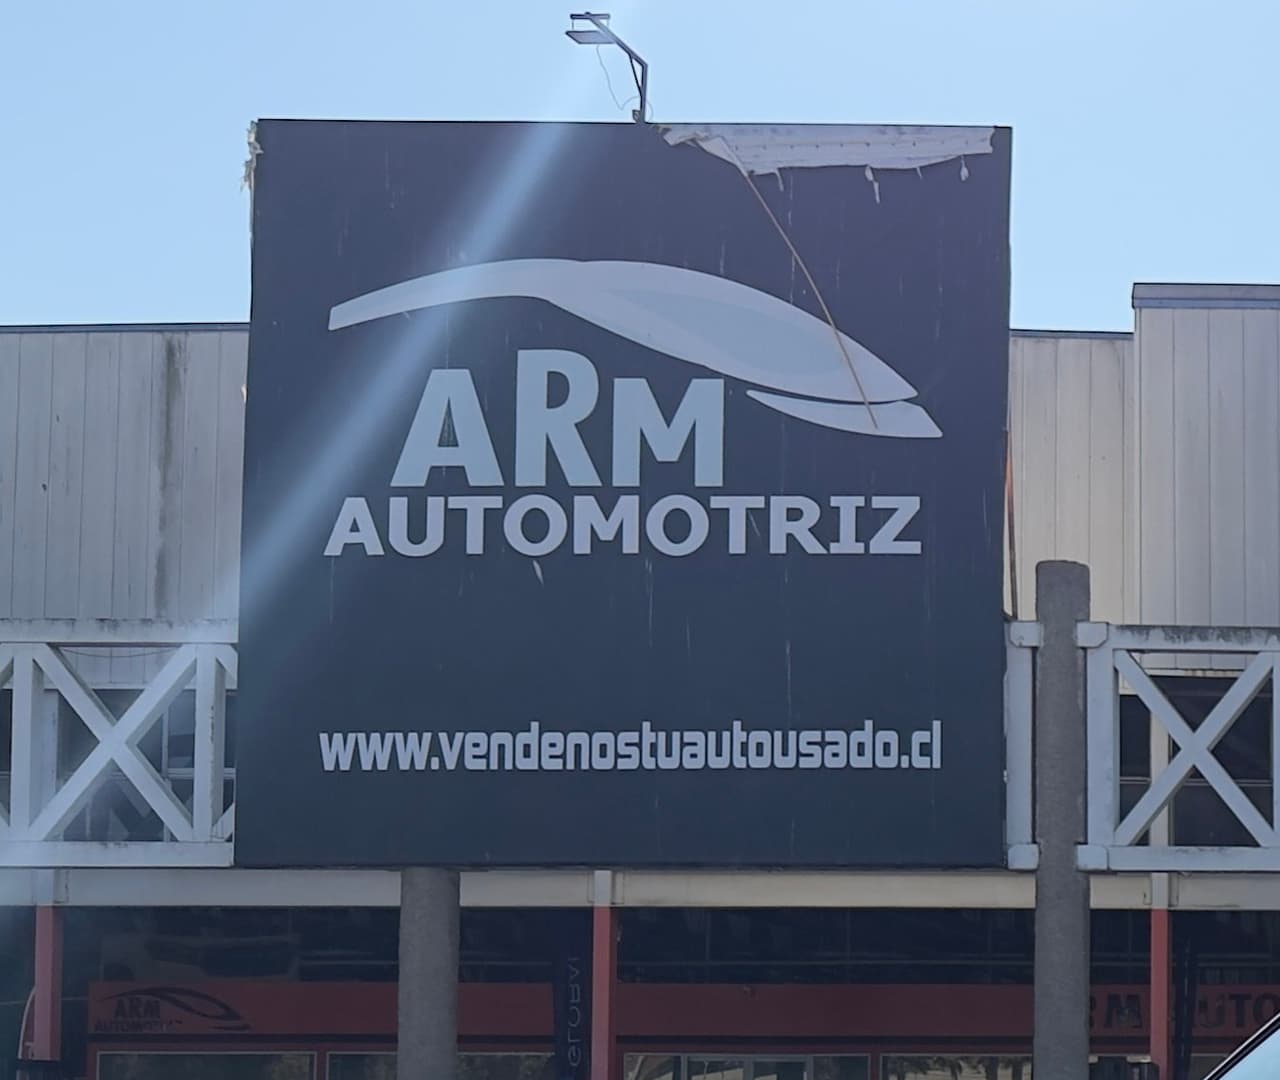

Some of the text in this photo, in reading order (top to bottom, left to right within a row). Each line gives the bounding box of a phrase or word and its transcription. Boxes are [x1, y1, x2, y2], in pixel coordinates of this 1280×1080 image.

[390, 349, 725, 488] ARM
[323, 494, 922, 557] AUTOMOTRIZ
[318, 719, 942, 773] www.vendenostuautousado.cl
